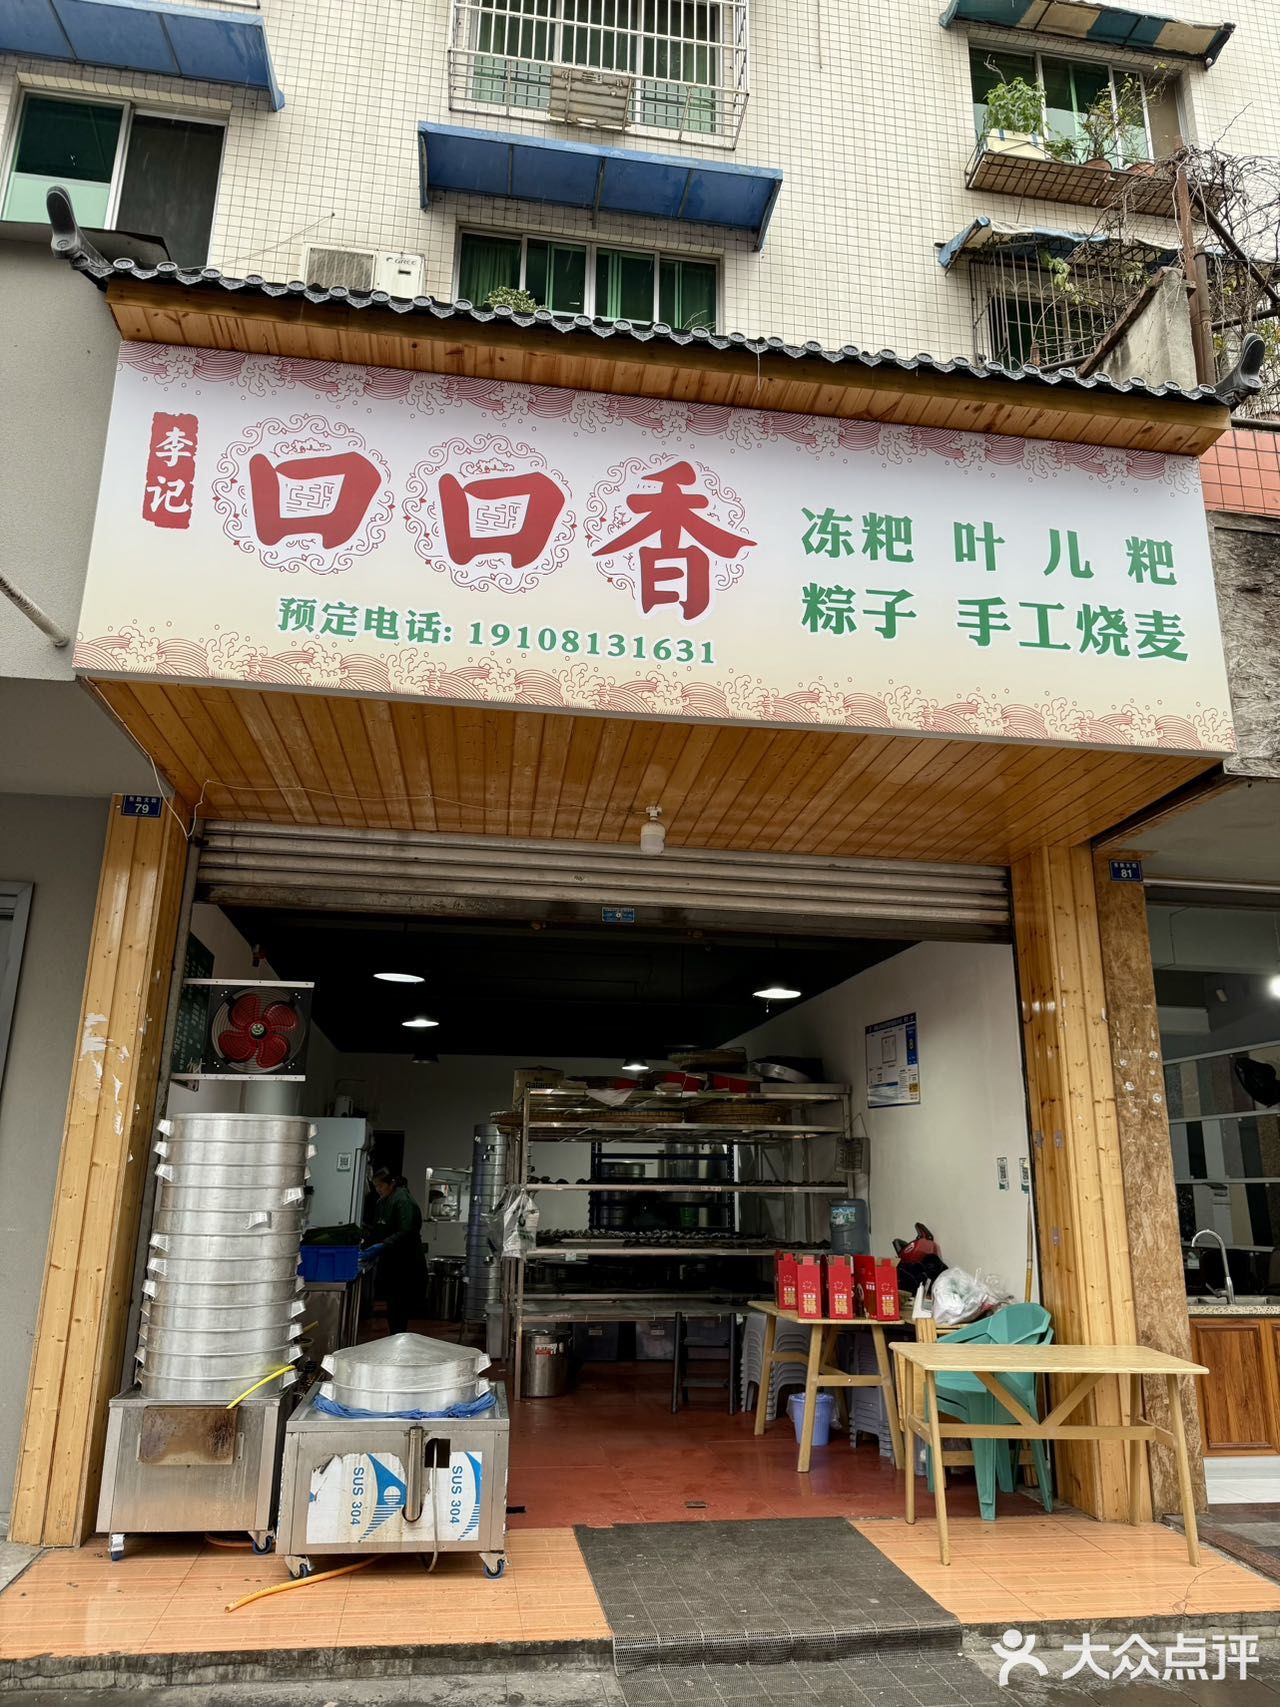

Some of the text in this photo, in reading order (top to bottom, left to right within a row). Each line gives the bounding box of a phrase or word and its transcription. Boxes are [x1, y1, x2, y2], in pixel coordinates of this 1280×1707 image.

[147, 426, 192, 514] 李记
[249, 451, 757, 620] 口口香
[801, 507, 1178, 587] 冻粑 叶儿粑
[470, 622, 715, 664] 19108131631
[801, 582, 1190, 662] 粽子 手工烧麦
[135, 803, 150, 814] 79
[1120, 868, 1132, 878] 81
[350, 1466, 365, 1526] SUS 304
[449, 1465, 463, 1524] SUS 304
